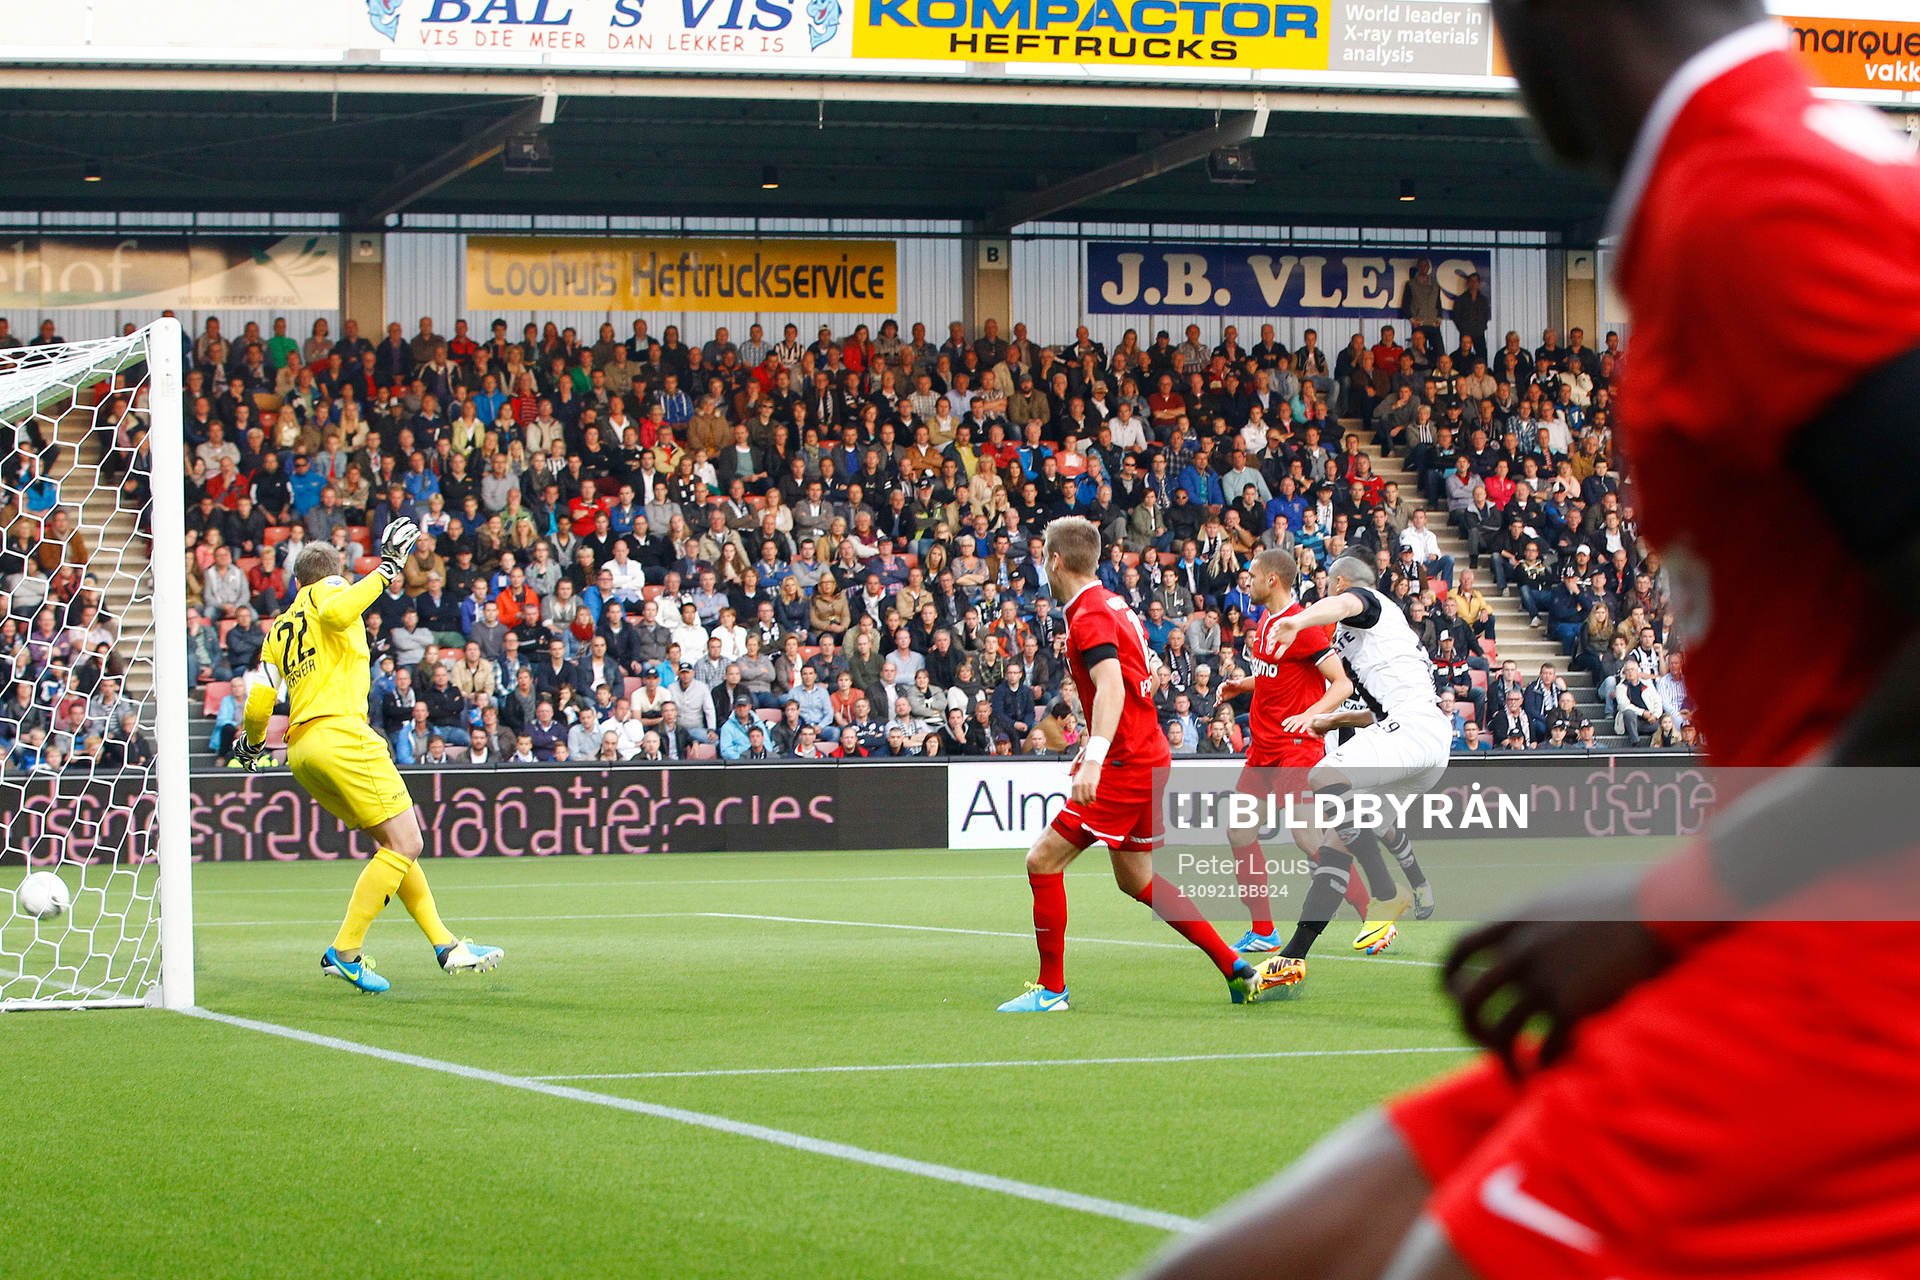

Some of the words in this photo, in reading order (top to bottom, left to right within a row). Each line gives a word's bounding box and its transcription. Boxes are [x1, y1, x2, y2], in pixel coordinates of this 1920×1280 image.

[868, 0, 1319, 38] KOMPACTOR
[1345, 4, 1399, 22] World
[1405, 5, 1461, 25] leader
[1466, 8, 1482, 25] in
[419, 29, 458, 46] VIS
[475, 30, 514, 47] DIE
[529, 31, 586, 49] MEER
[608, 33, 653, 50] DAN
[667, 34, 745, 51] LEKKER
[760, 36, 785, 53] IS
[950, 33, 1237, 60] HEFTRUCKS
[1344, 24, 1392, 46] X-ray
[1397, 27, 1479, 46] materials
[1343, 45, 1415, 67] analysis
[0, 239, 139, 293] hof
[987, 247, 1000, 263] B
[484, 248, 617, 298] Loohuis
[633, 250, 885, 300] Heftruckservice
[1101, 252, 1231, 307] J.B.
[1247, 254, 1479, 310] VLES
